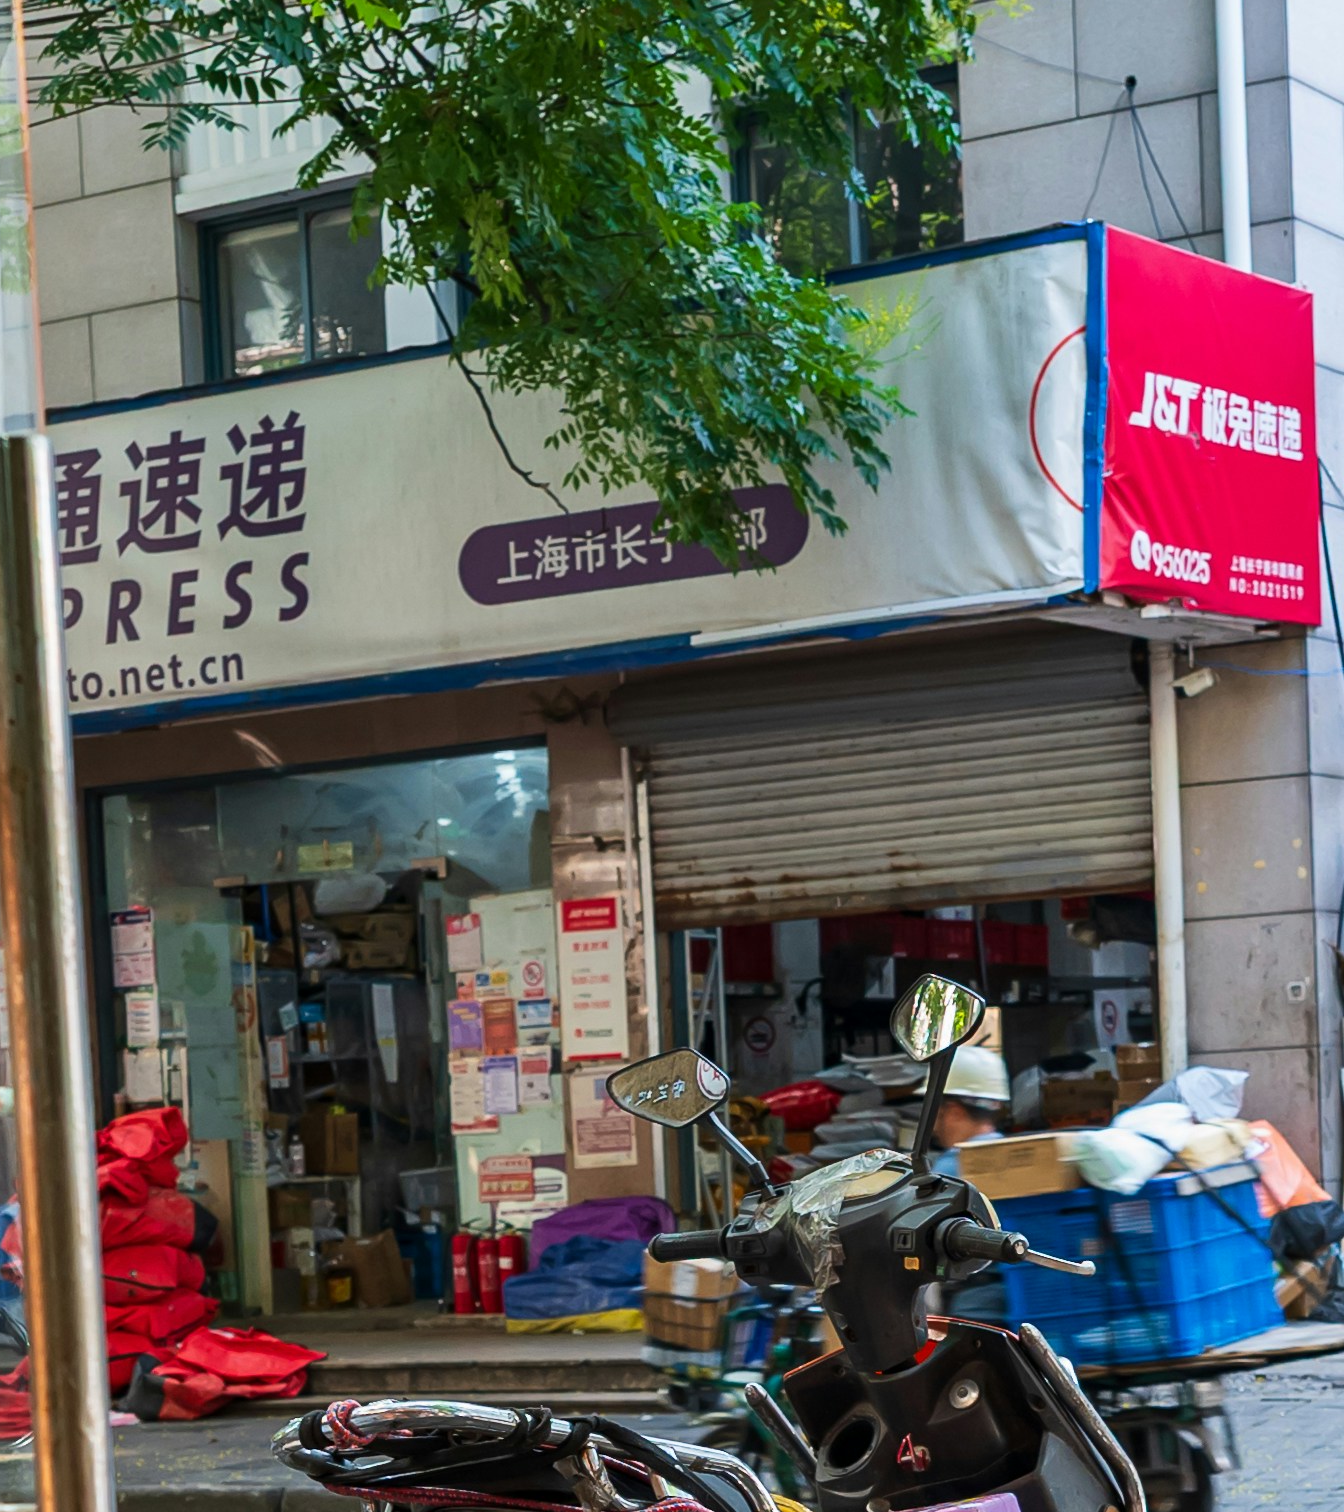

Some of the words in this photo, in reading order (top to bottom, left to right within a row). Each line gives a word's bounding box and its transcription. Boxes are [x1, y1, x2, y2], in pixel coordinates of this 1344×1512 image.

[1128, 371, 1202, 435] J&T
[1201, 386, 1304, 461] 极兔速递
[53, 410, 307, 567] 通速递
[496, 507, 768, 585] 上海市长宁部
[1152, 542, 1212, 585] 956025
[66, 652, 244, 703] to.net.cn
